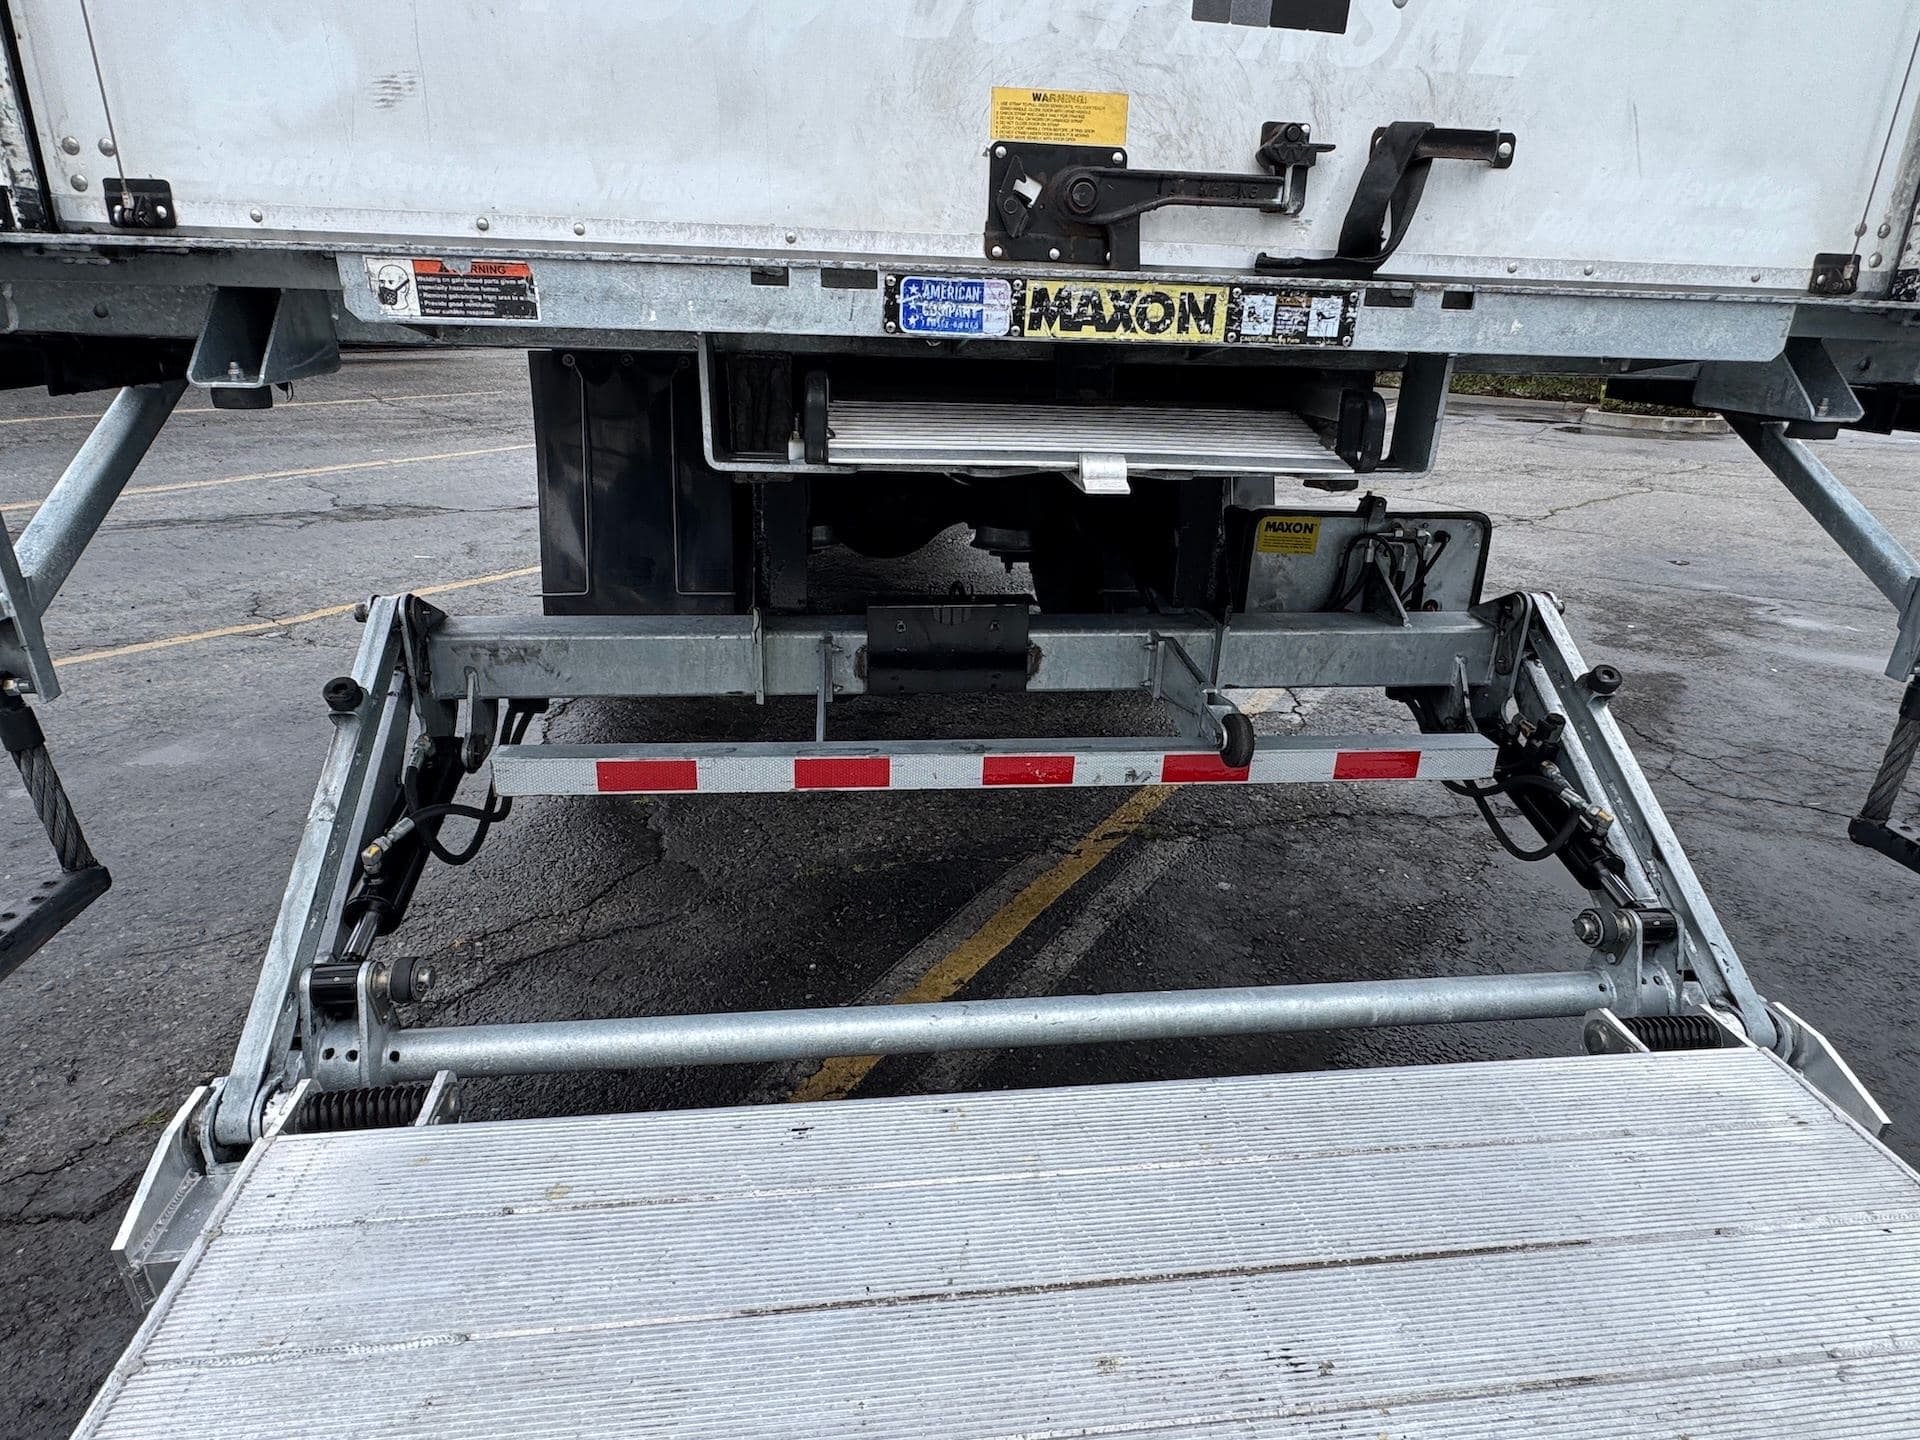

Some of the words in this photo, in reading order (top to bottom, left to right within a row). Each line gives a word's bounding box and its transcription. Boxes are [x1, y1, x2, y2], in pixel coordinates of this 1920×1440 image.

[922, 283, 980, 302] AMERICAN
[1028, 287, 1217, 336] MAXON
[1264, 521, 1314, 534] MAXON
